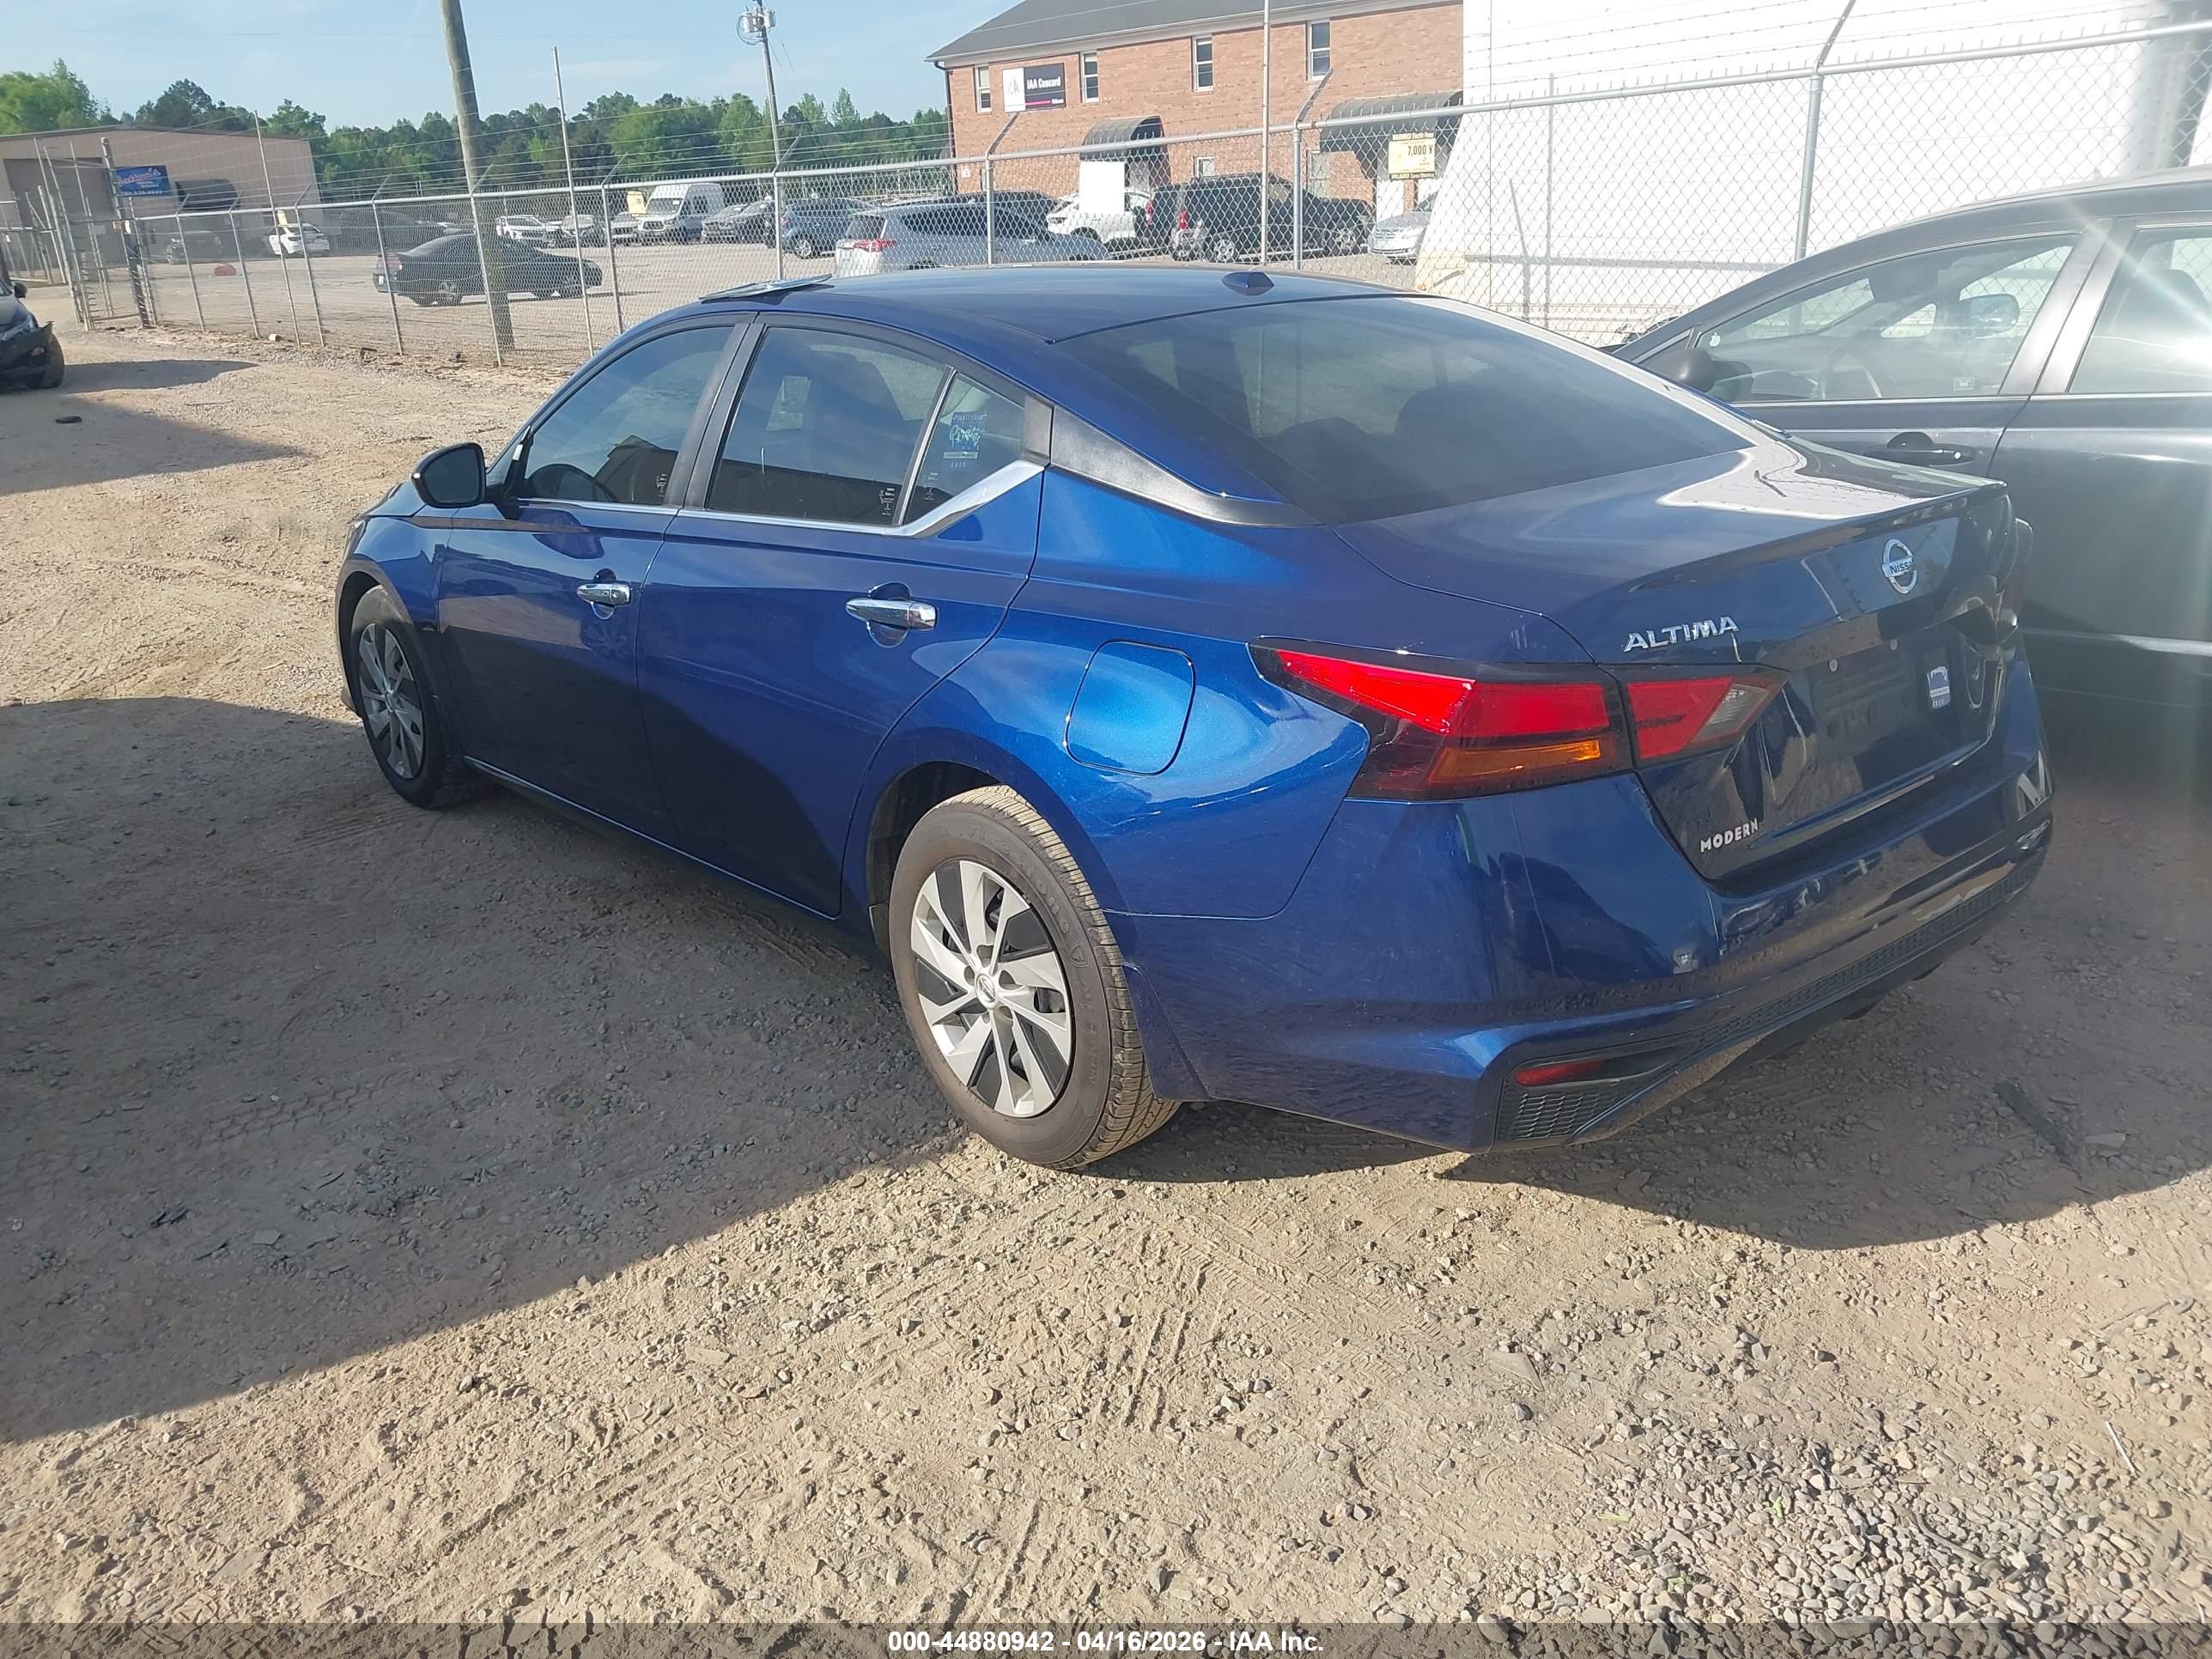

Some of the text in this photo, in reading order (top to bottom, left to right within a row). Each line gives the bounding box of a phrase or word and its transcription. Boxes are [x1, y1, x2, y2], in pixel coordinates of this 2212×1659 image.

[1027, 79, 1037, 89] IAA
[1407, 144, 1427, 157] 7,000
[1623, 616, 1740, 653] ALTIMA
[1700, 817, 1759, 853] MODERN
